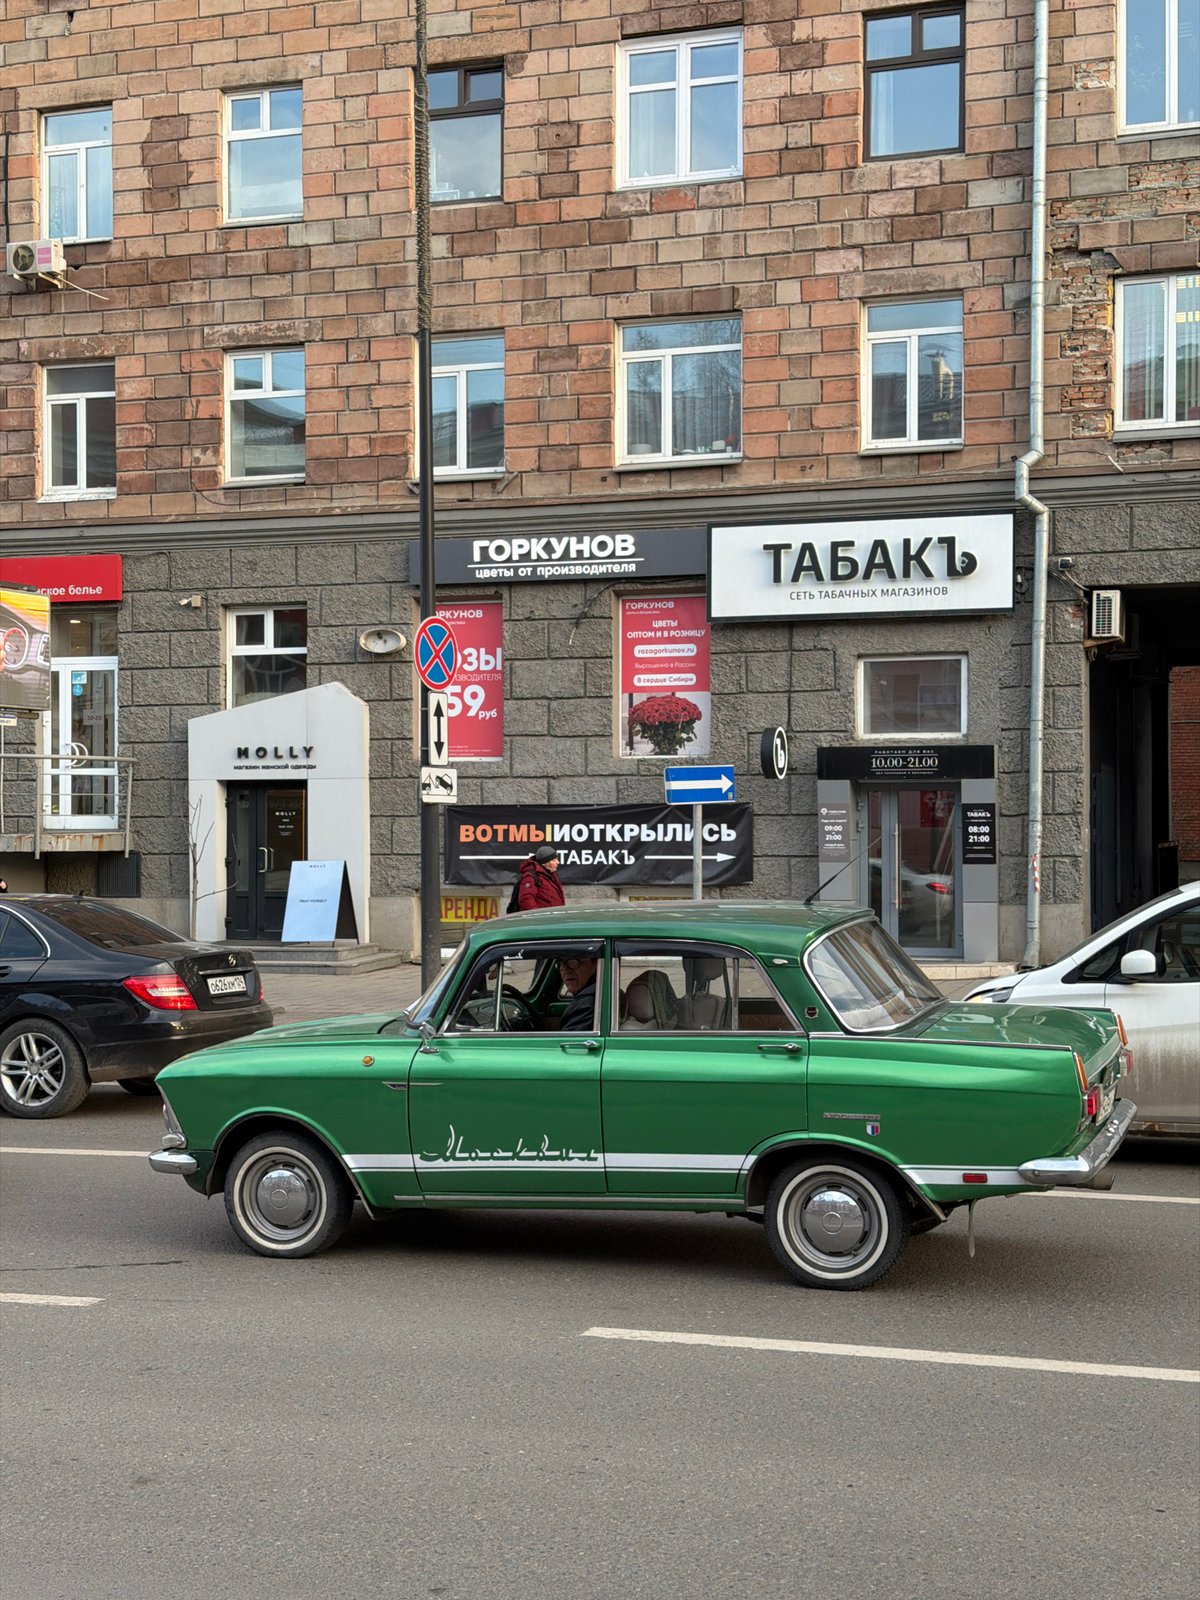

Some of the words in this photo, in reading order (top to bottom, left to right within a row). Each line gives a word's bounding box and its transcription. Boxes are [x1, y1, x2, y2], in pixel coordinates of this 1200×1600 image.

[473, 534, 636, 562] ГОРКУНОВ
[762, 536, 978, 584] ТАБАКЪ
[476, 566, 514, 579] цветы
[518, 566, 532, 576] от
[537, 563, 636, 578] производителя
[37, 587, 66, 596] ское
[68, 584, 103, 596] белье
[789, 591, 815, 600] СЕТЬ
[818, 588, 877, 600] ТАБАЧНЫХ
[880, 586, 948, 598] МАГАЗИНОВ
[435, 609, 483, 619] РКУНОВ
[652, 620, 678, 628] ЦВЕТЫ
[627, 631, 655, 639] ОПТОМ
[664, 630, 669, 638] В
[670, 629, 706, 638] РОЗНИЦУ
[457, 647, 502, 671] ЗЫ
[456, 673, 502, 682] ЗВОДИТЕЛЯ
[478, 708, 498, 720] руб
[237, 746, 314, 759] MOLLY
[871, 756, 938, 768] 10.00-21.00
[968, 825, 990, 833] 08:00
[968, 835, 990, 843] 21:00
[556, 849, 636, 865] ТАБАКЪ
[440, 898, 499, 921] РЕНДА
